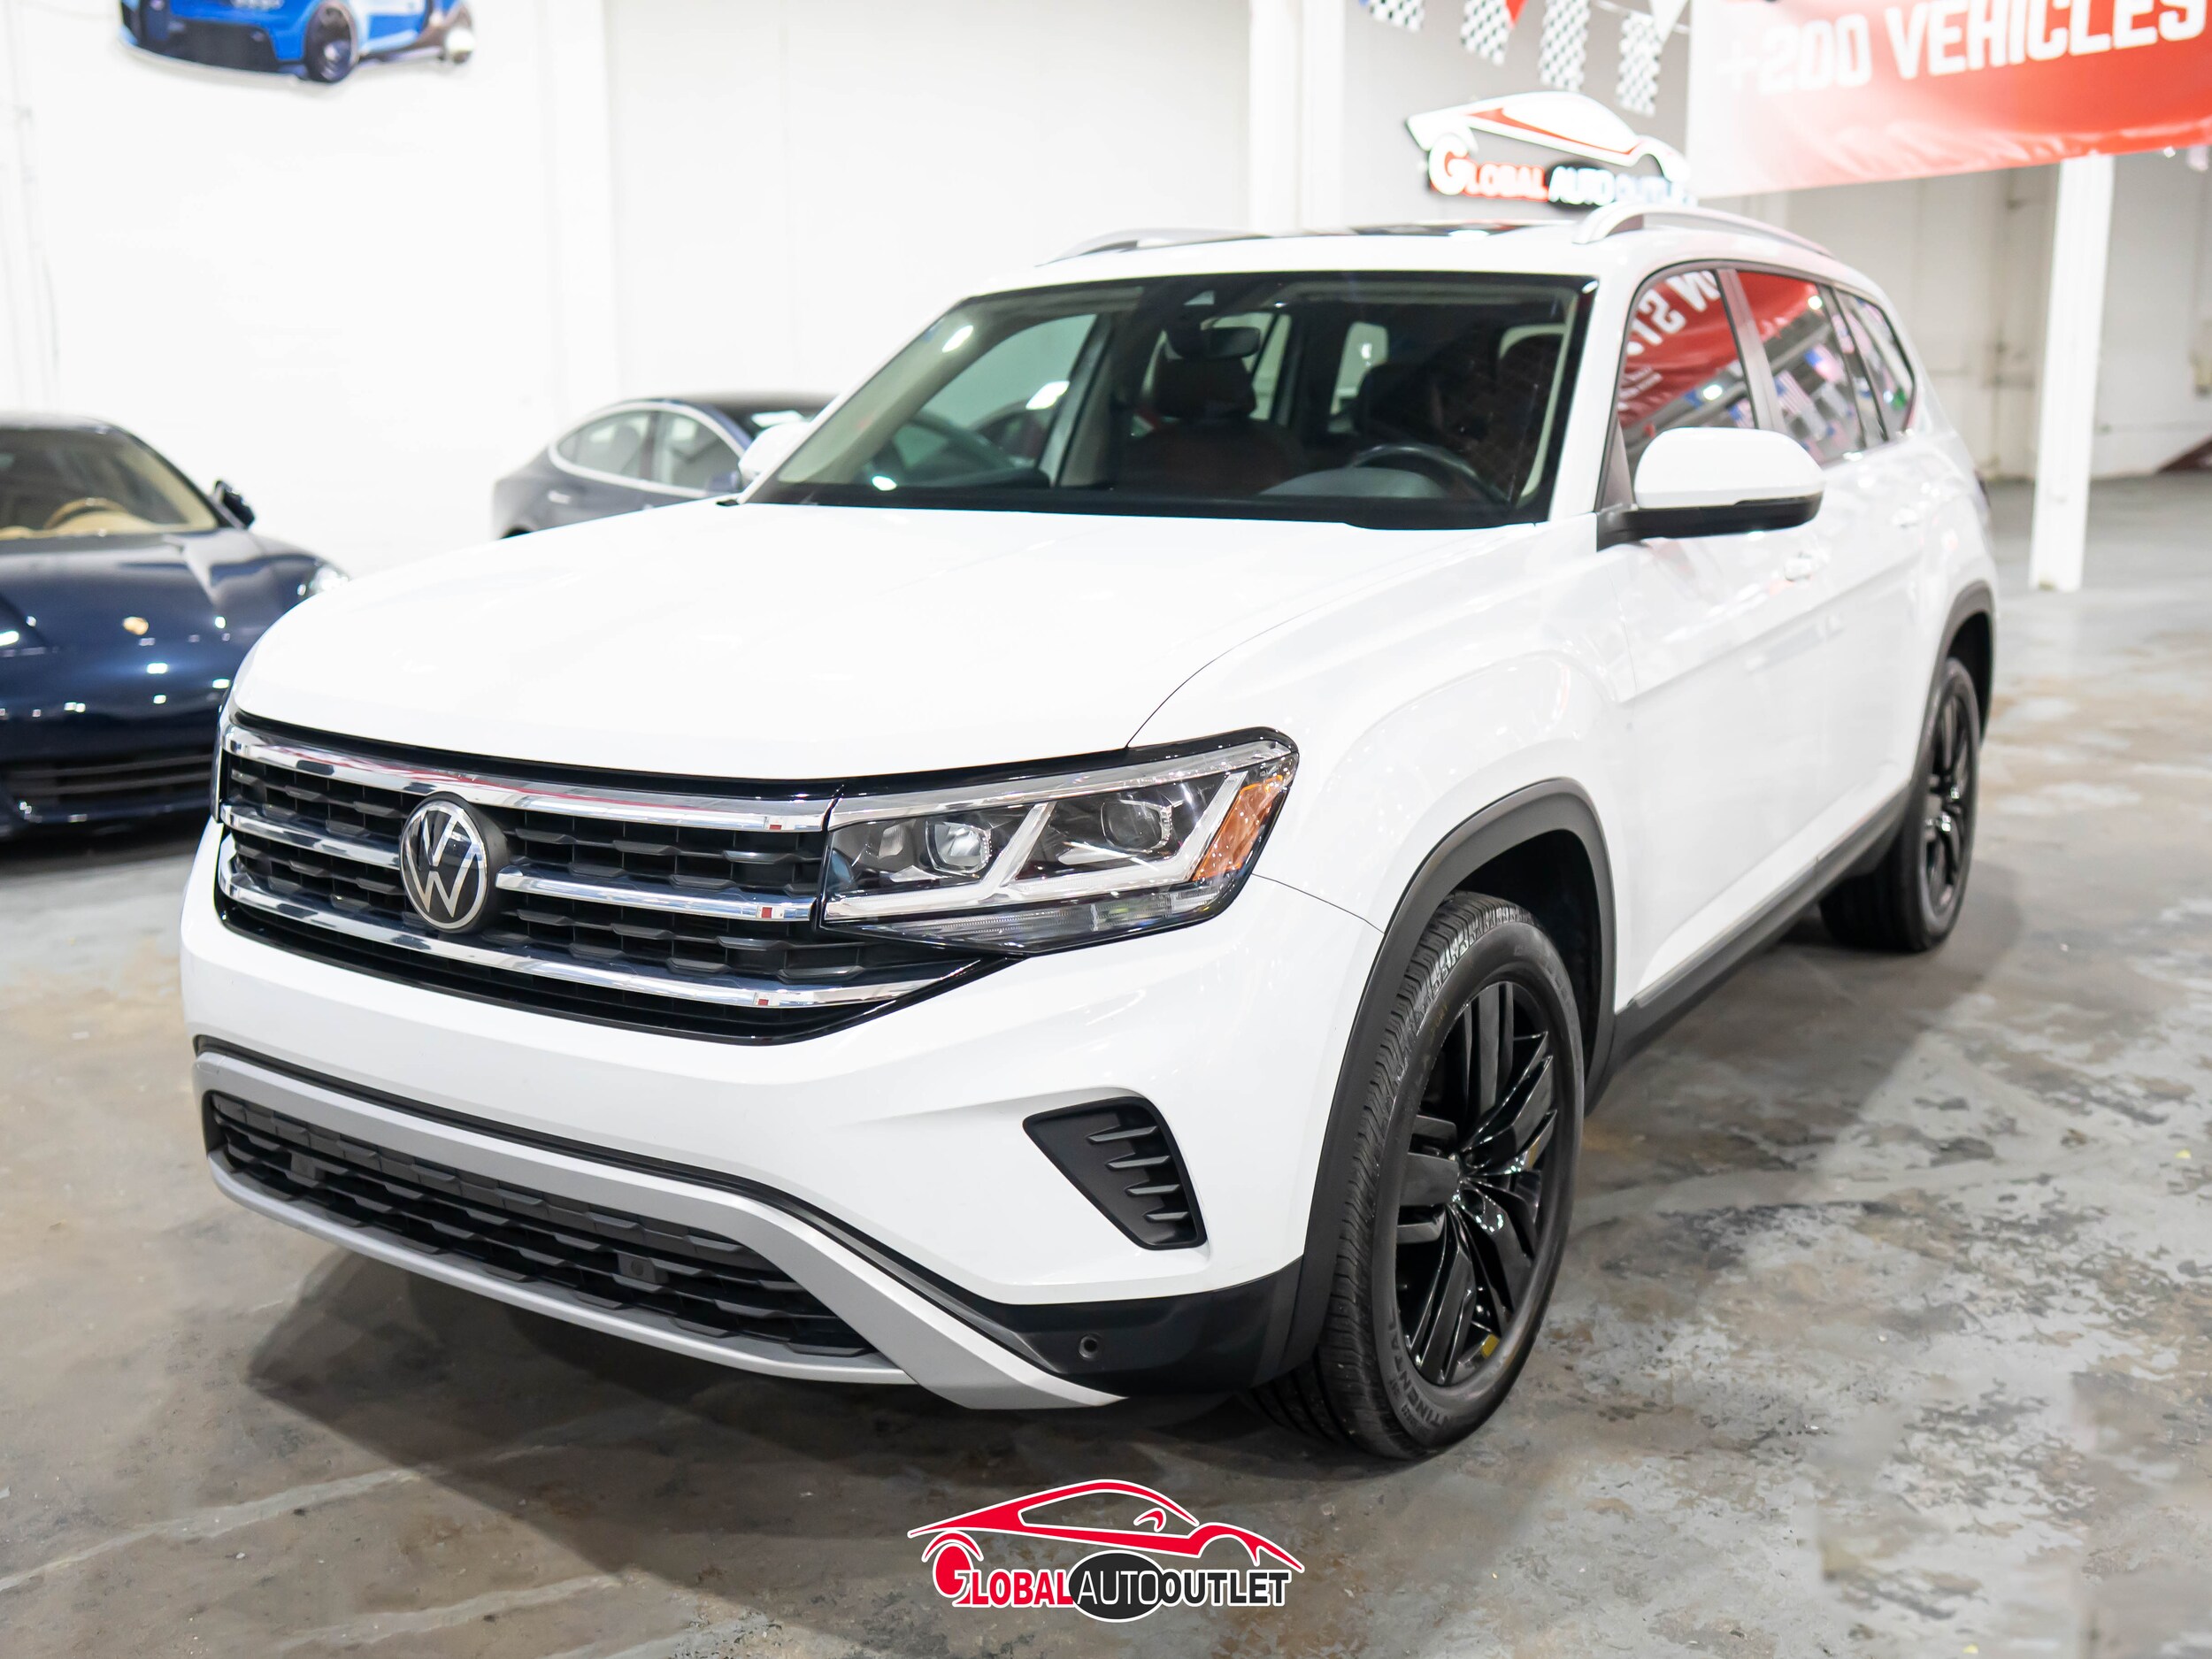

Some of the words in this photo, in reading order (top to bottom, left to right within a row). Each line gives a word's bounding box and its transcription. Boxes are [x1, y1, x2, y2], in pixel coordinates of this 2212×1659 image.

[1716, 13, 1872, 96] +200
[1886, 0, 2207, 80] VEHICLES
[1428, 133, 1548, 202] GLOBAL
